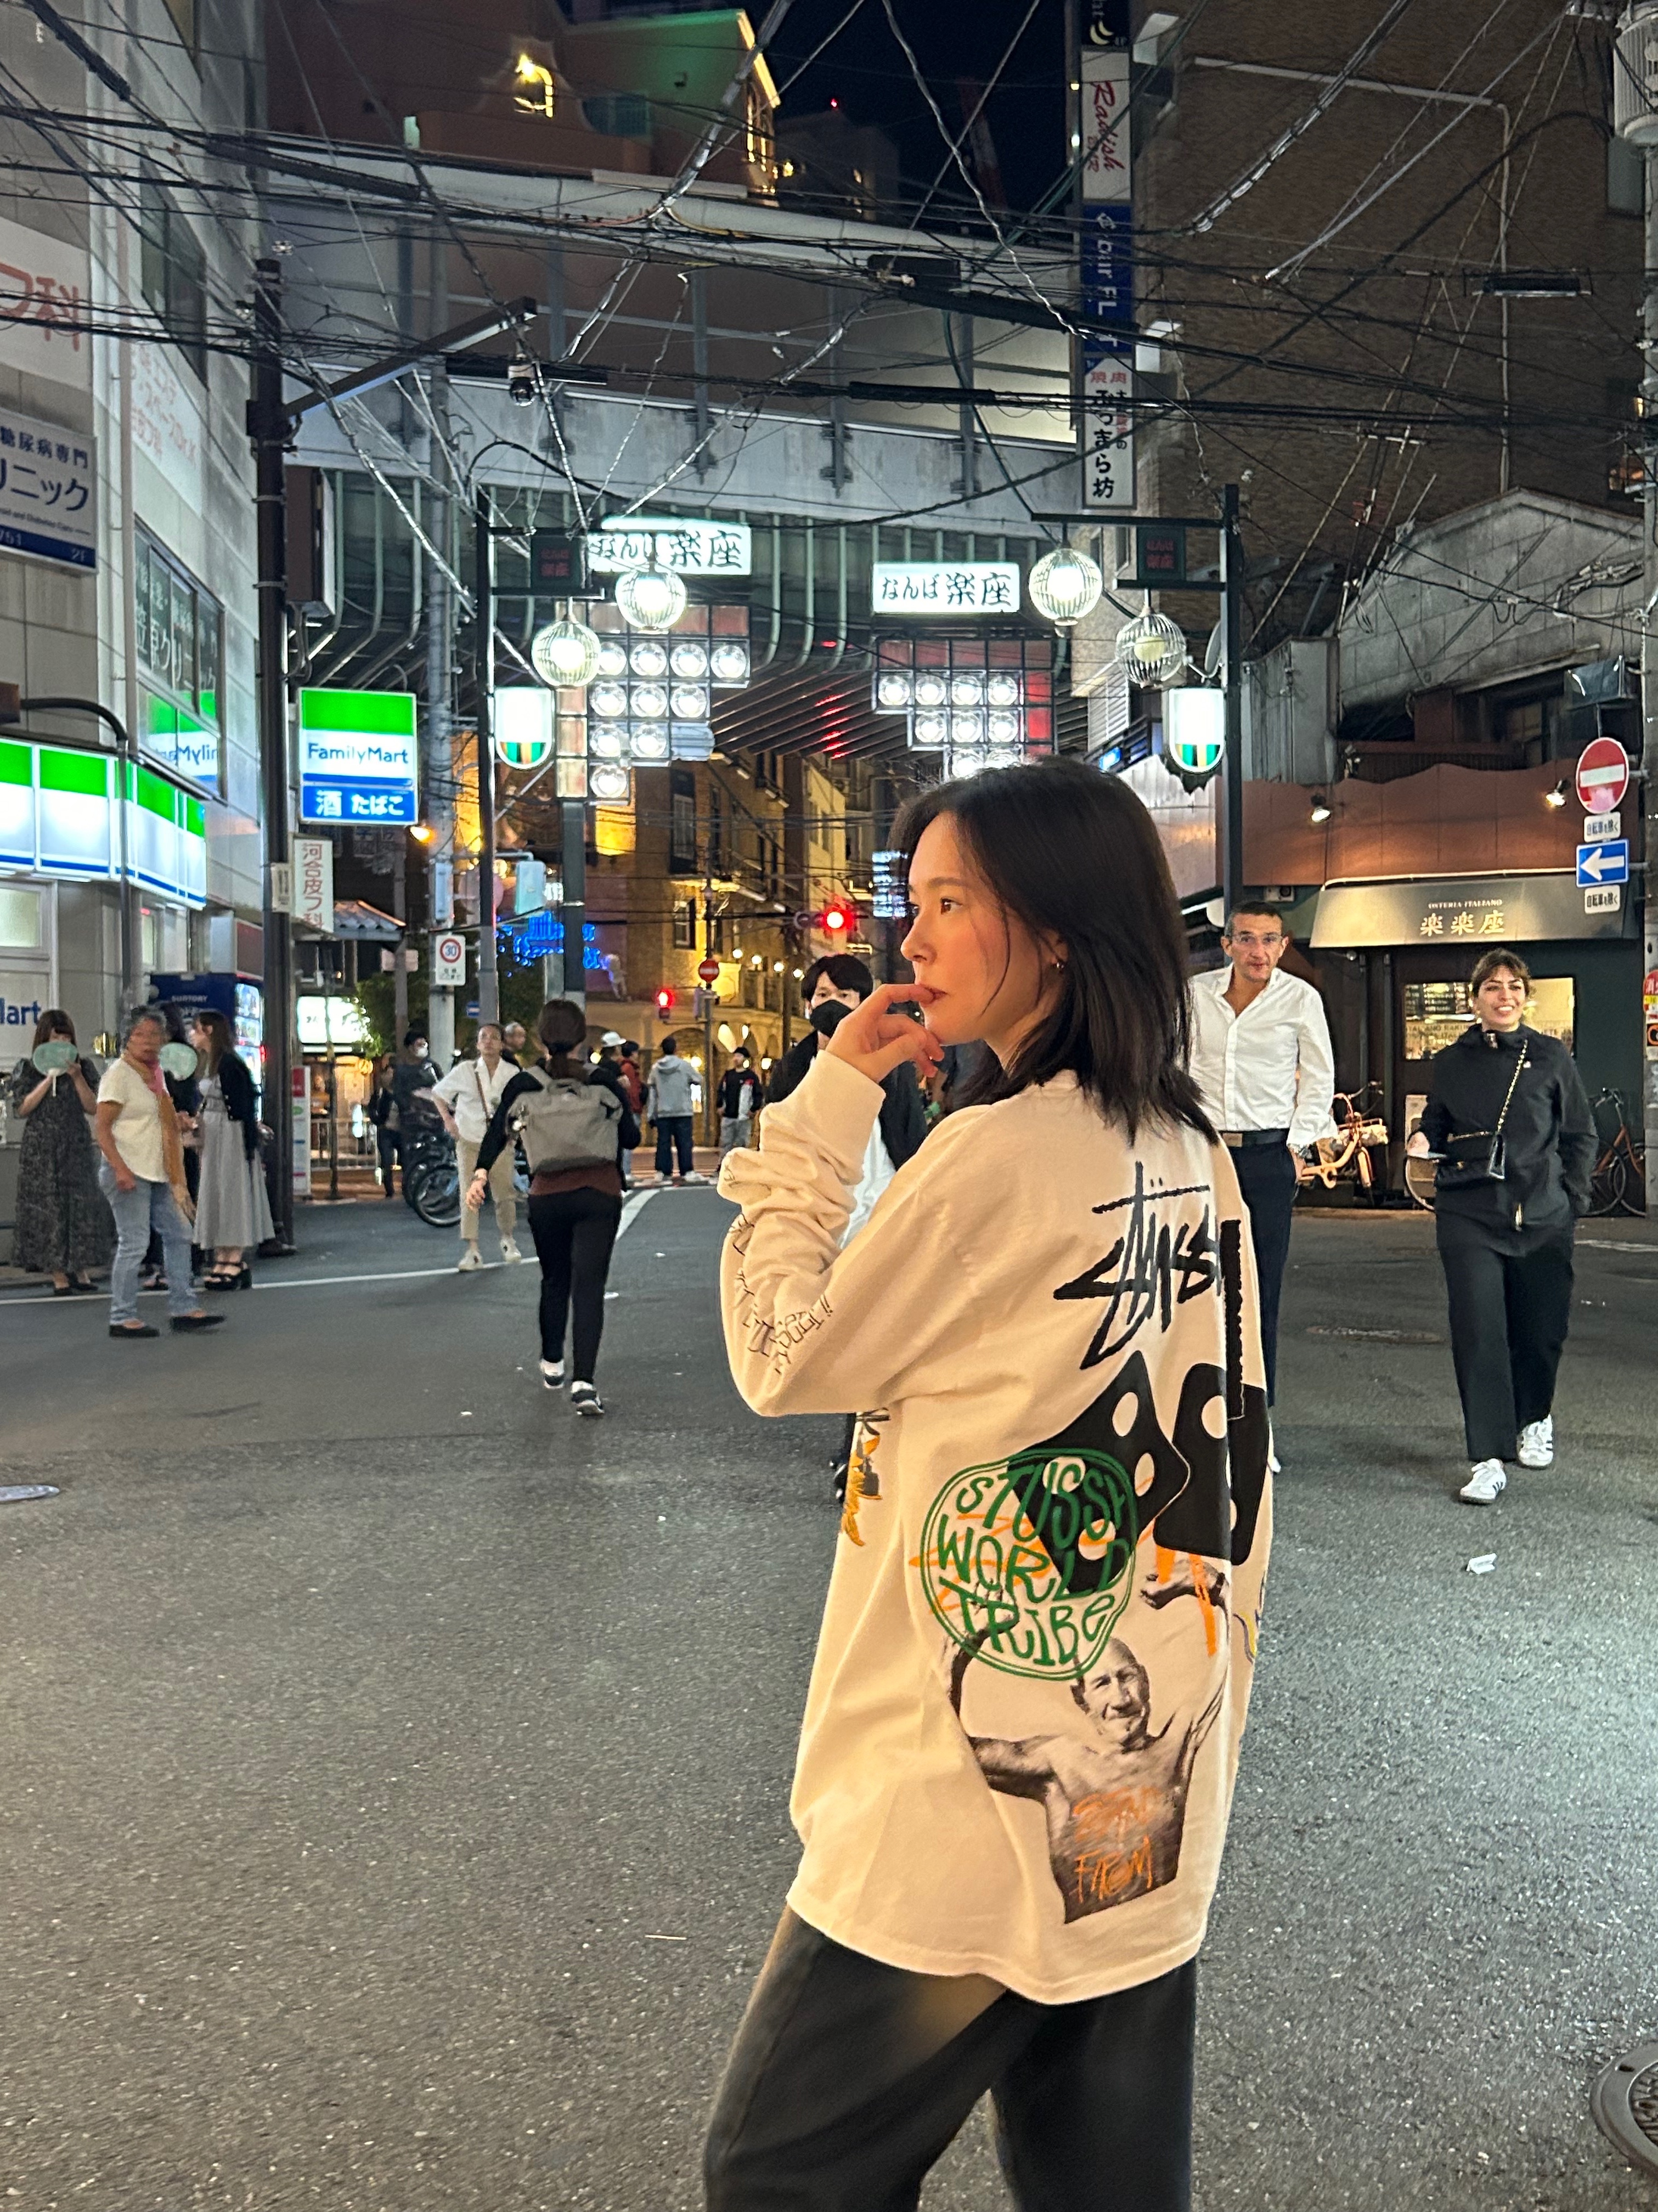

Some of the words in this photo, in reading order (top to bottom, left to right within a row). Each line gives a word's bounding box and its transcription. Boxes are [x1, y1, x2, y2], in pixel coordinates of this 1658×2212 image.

[881, 572, 1012, 607] なんば楽座
[307, 742, 409, 765] FamilyMart
[315, 791, 342, 817] 酒
[351, 794, 404, 816] たばこ
[1419, 909, 1505, 937] 楽楽座
[444, 944, 457, 957] 30
